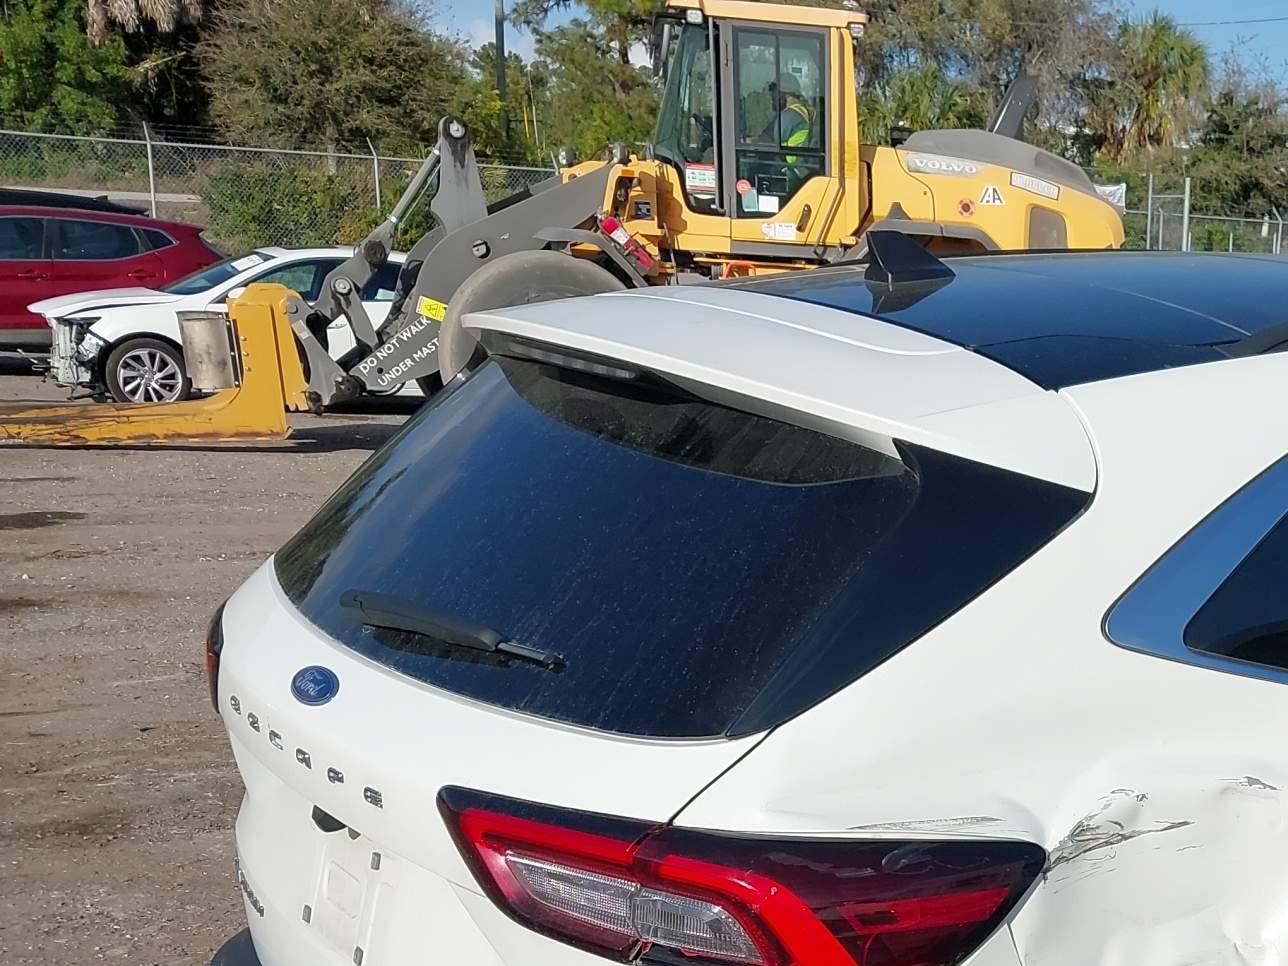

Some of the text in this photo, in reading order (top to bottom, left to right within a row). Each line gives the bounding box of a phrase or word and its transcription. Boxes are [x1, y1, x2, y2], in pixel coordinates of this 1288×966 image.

[914, 159, 977, 174] VOLVO
[360, 316, 432, 376] DO NOT WALK
[377, 338, 440, 386] UNDER MAST
[230, 695, 383, 809] ESCAPE
